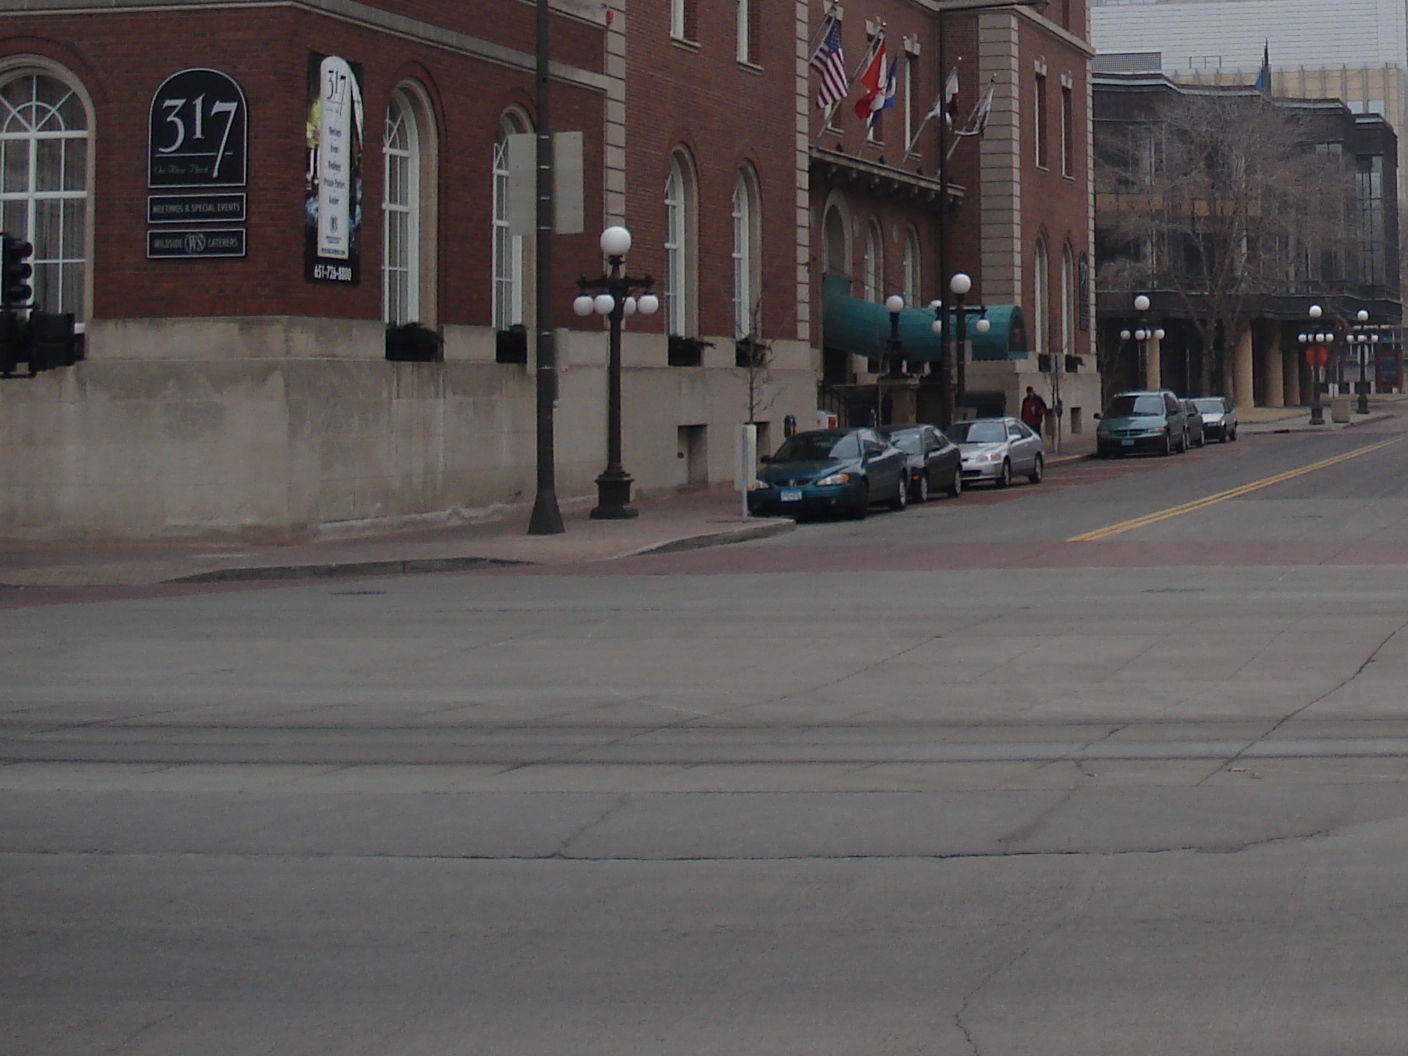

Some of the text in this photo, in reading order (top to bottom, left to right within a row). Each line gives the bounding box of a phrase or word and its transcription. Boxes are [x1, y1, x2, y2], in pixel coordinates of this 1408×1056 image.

[327, 70, 347, 116] 317
[158, 93, 239, 178] 317
[191, 203, 215, 213] SPECIAL
[217, 202, 241, 212] EVENTS
[207, 237, 239, 248] CATERERS
